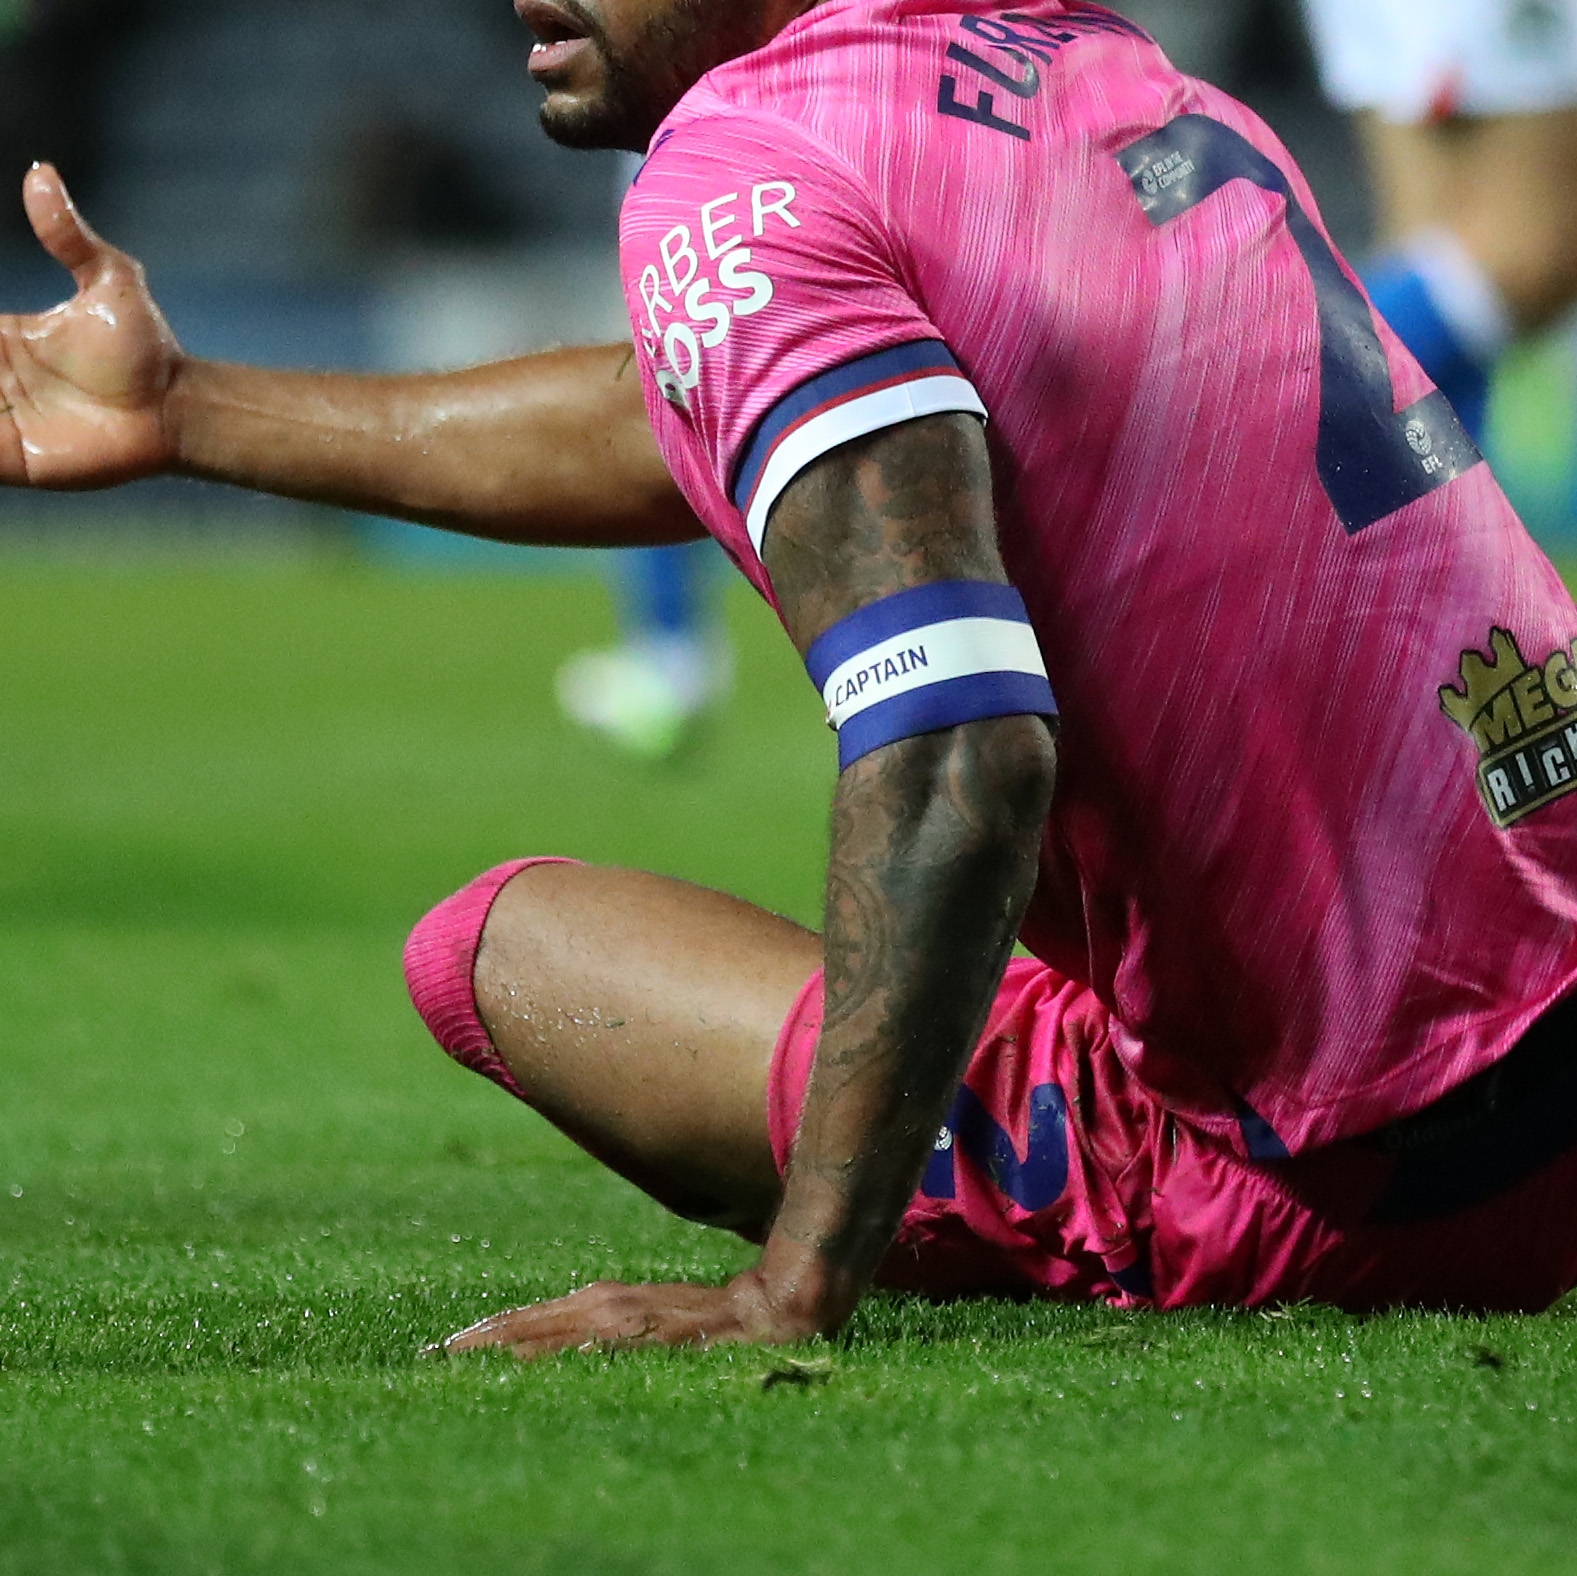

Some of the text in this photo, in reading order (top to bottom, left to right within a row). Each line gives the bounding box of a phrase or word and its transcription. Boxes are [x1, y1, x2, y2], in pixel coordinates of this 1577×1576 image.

[1115, 113, 1484, 535] 2
[1420, 453, 1444, 475] EFL
[835, 644, 929, 707] CAPTAIN
